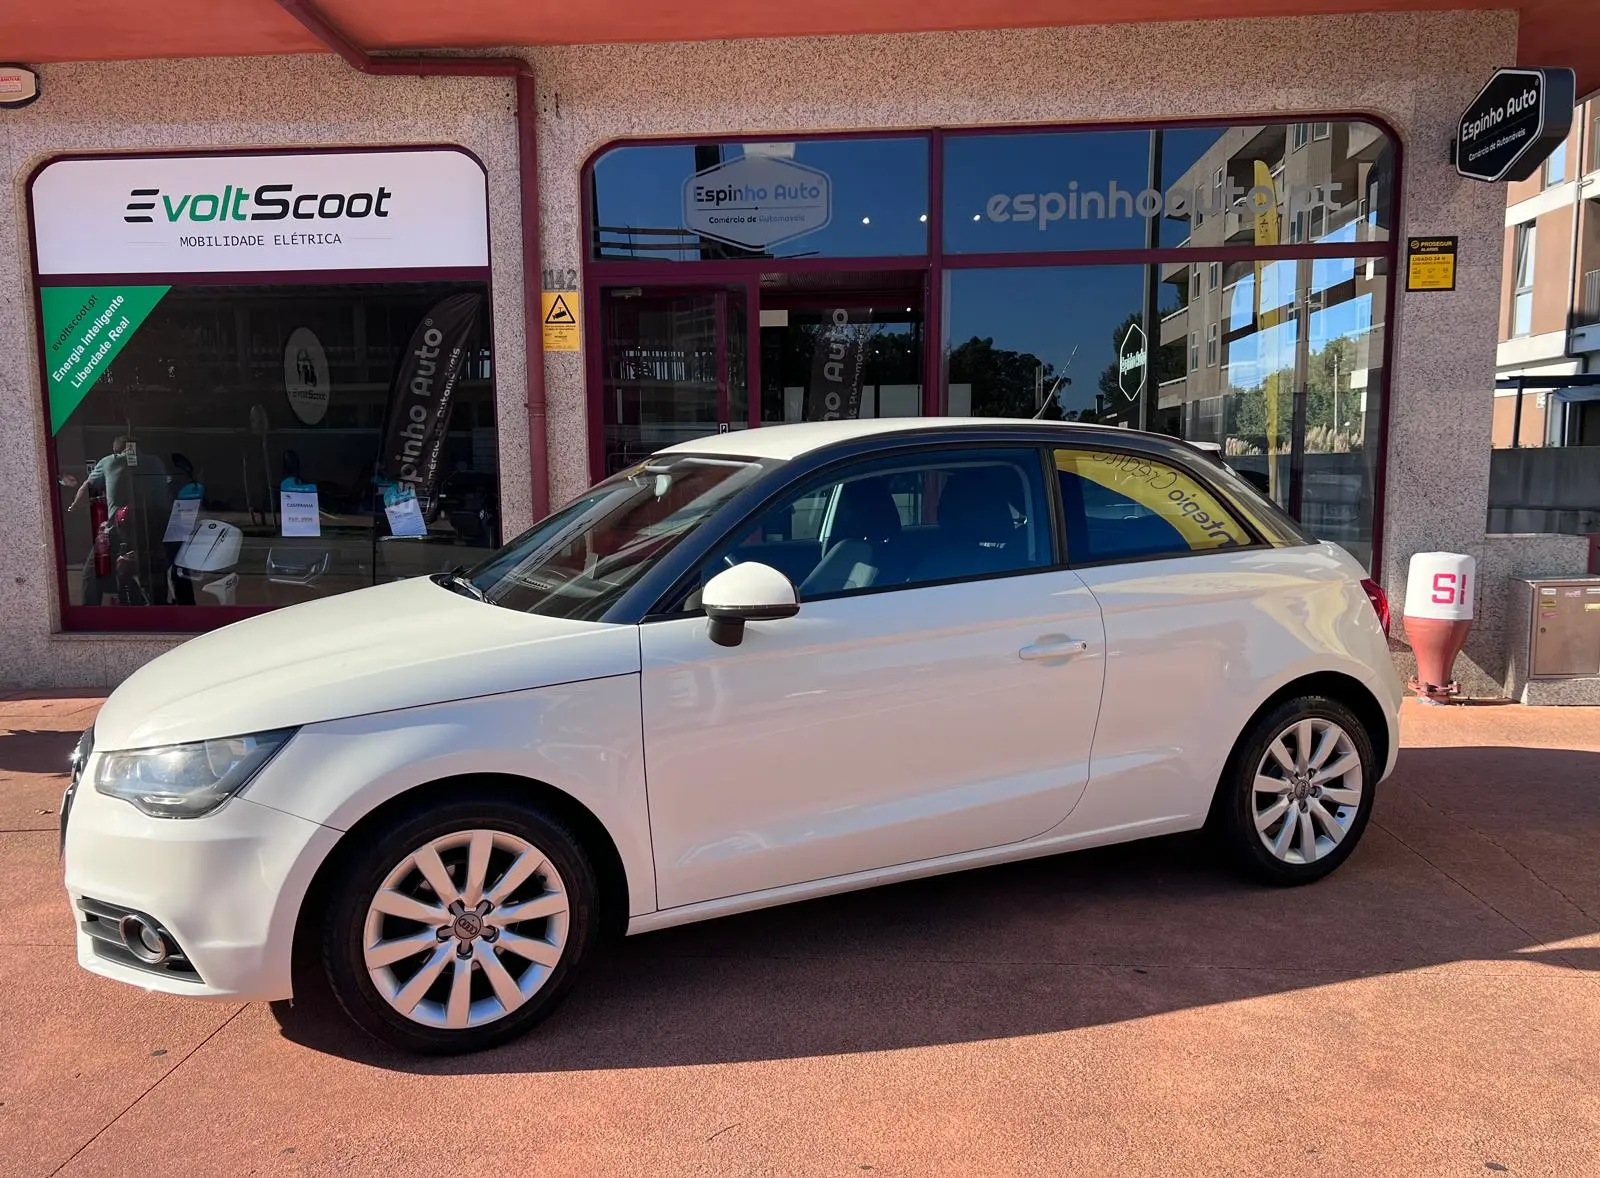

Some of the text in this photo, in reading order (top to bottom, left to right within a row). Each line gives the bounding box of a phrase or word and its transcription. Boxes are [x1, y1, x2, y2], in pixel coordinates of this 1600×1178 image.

[1461, 89, 1537, 142] Espinho Auto
[124, 184, 392, 223] EvoltScoot
[694, 182, 820, 206] Espinho Auto
[709, 215, 745, 224] Comércio
[747, 215, 757, 223] de
[986, 178, 1343, 231] espinhoauto.pt
[180, 231, 342, 248] MOBILIDADE ELÉTRICA
[52, 294, 99, 352] evoltscoot.pt
[52, 295, 124, 382] Energia Inteligente
[823, 308, 849, 382] Auto
[70, 316, 131, 389] Liberdade Real
[410, 328, 443, 397] Auto
[395, 405, 427, 497] spinho
